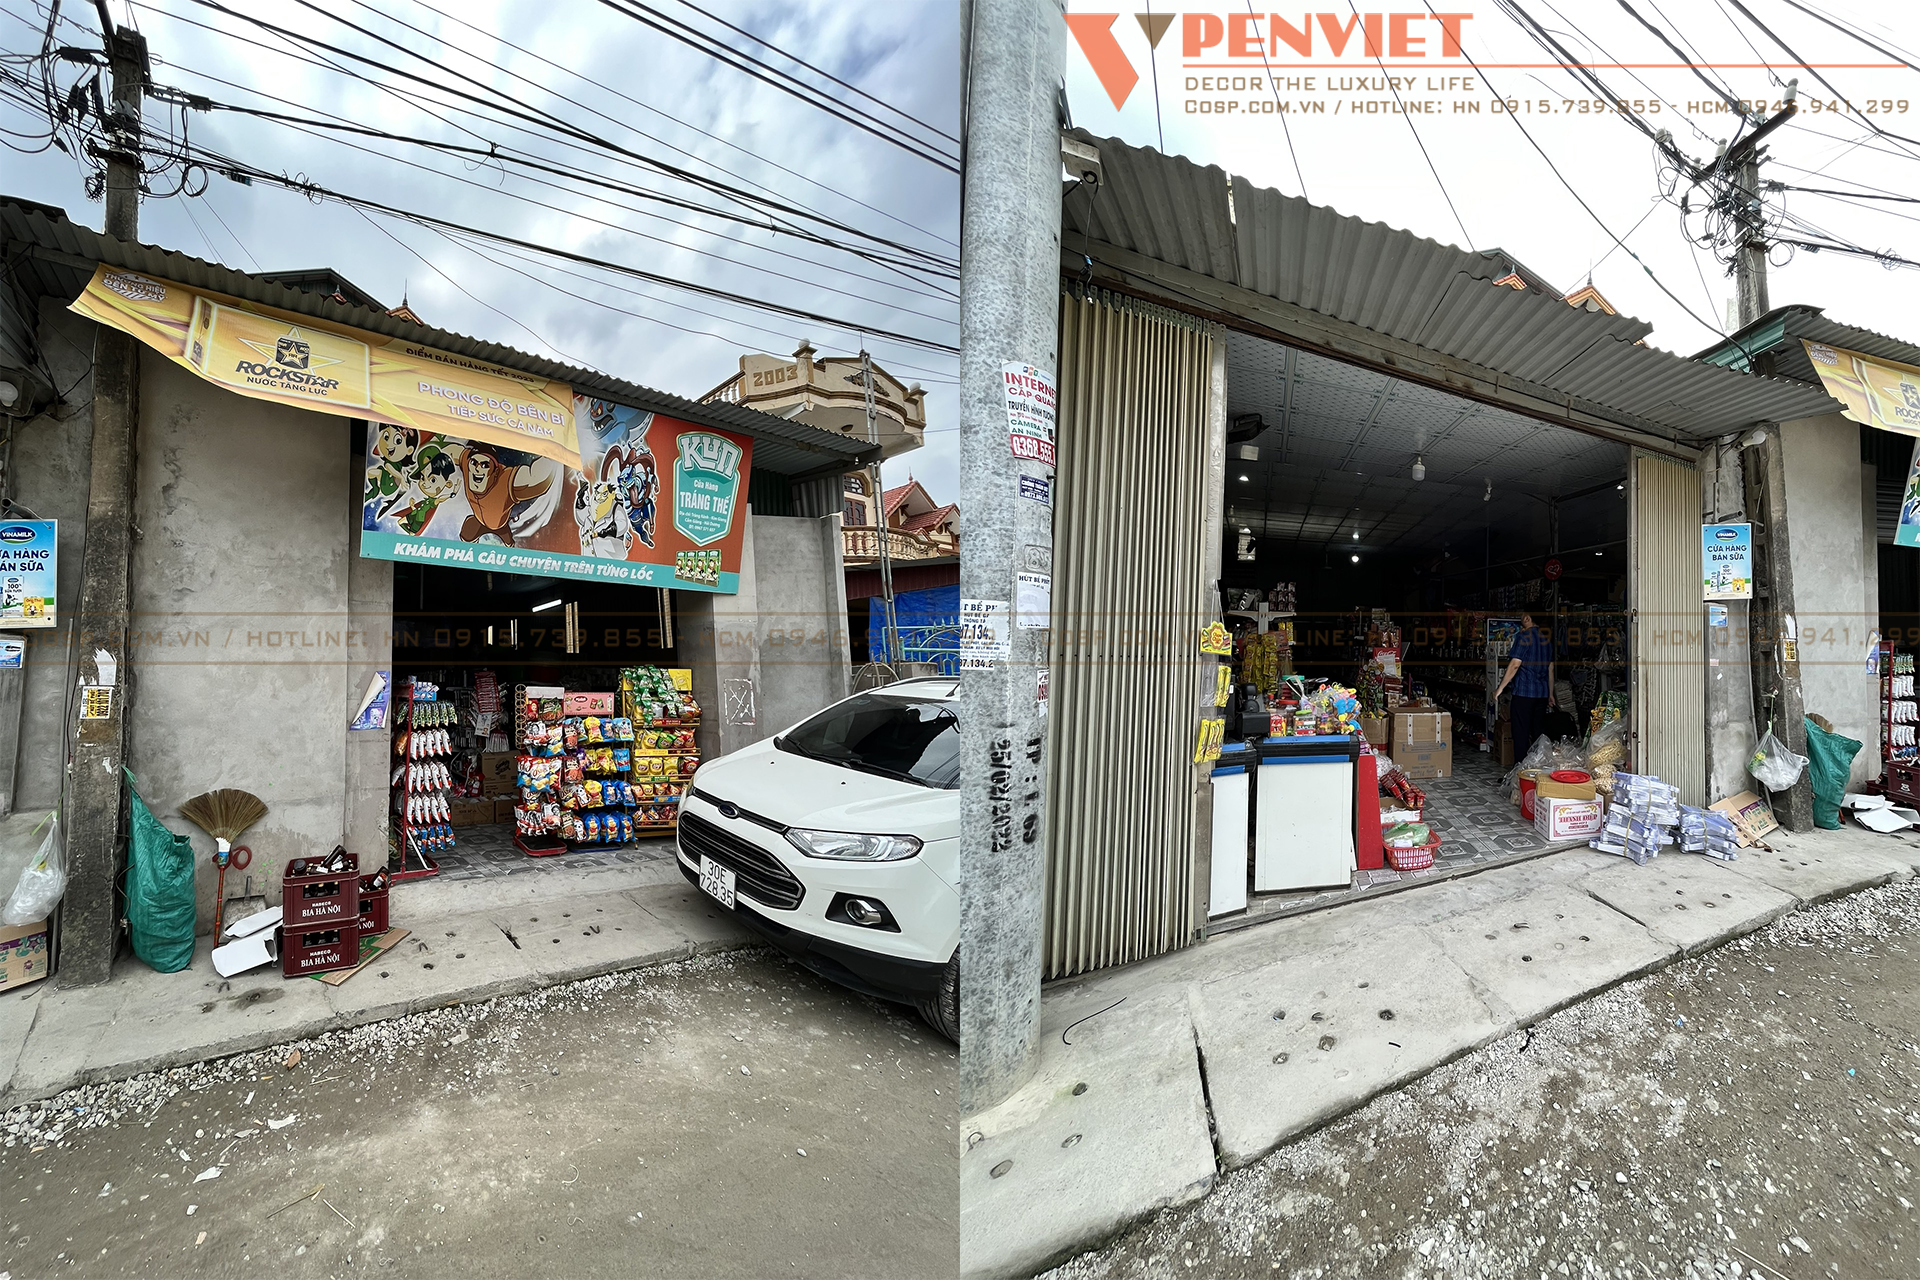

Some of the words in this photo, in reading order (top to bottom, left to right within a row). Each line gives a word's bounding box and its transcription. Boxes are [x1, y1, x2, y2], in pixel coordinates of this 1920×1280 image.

[434, 352, 458, 366] BÁN
[459, 360, 489, 373] HÀNG
[490, 366, 509, 377] TẾT
[753, 364, 798, 387] 2003
[417, 381, 484, 405] PHONG
[487, 396, 514, 415] ĐỘ
[1010, 419, 1042, 432] CAMERA
[1011, 427, 1024, 435] AN
[680, 490, 710, 511] TRÁNG
[712, 495, 732, 515] THẾ
[13, 547, 50, 559] HÀNG
[1707, 543, 1724, 552] CỬA
[1725, 543, 1747, 552] HÀNG
[393, 542, 441, 559] KHÁM
[443, 547, 474, 562] PHÁ
[477, 549, 507, 566] CÂU
[508, 555, 562, 573] CHUYỆN
[563, 560, 593, 575] TRÊN
[630, 565, 654, 581] LỐC
[1712, 552, 1728, 561] BÁN
[1729, 551, 1745, 561] SỮA
[19, 559, 45, 572] SỮA
[707, 860, 727, 885] 30E
[700, 872, 734, 907] 728.35
[302, 908, 315, 917] BIA
[315, 905, 326, 915] HÀ
[327, 904, 341, 914] NỘI
[362, 920, 375, 929] NỘI
[300, 959, 314, 968] BIA
[314, 955, 326, 965] HÀ
[326, 953, 340, 963] NỘI
